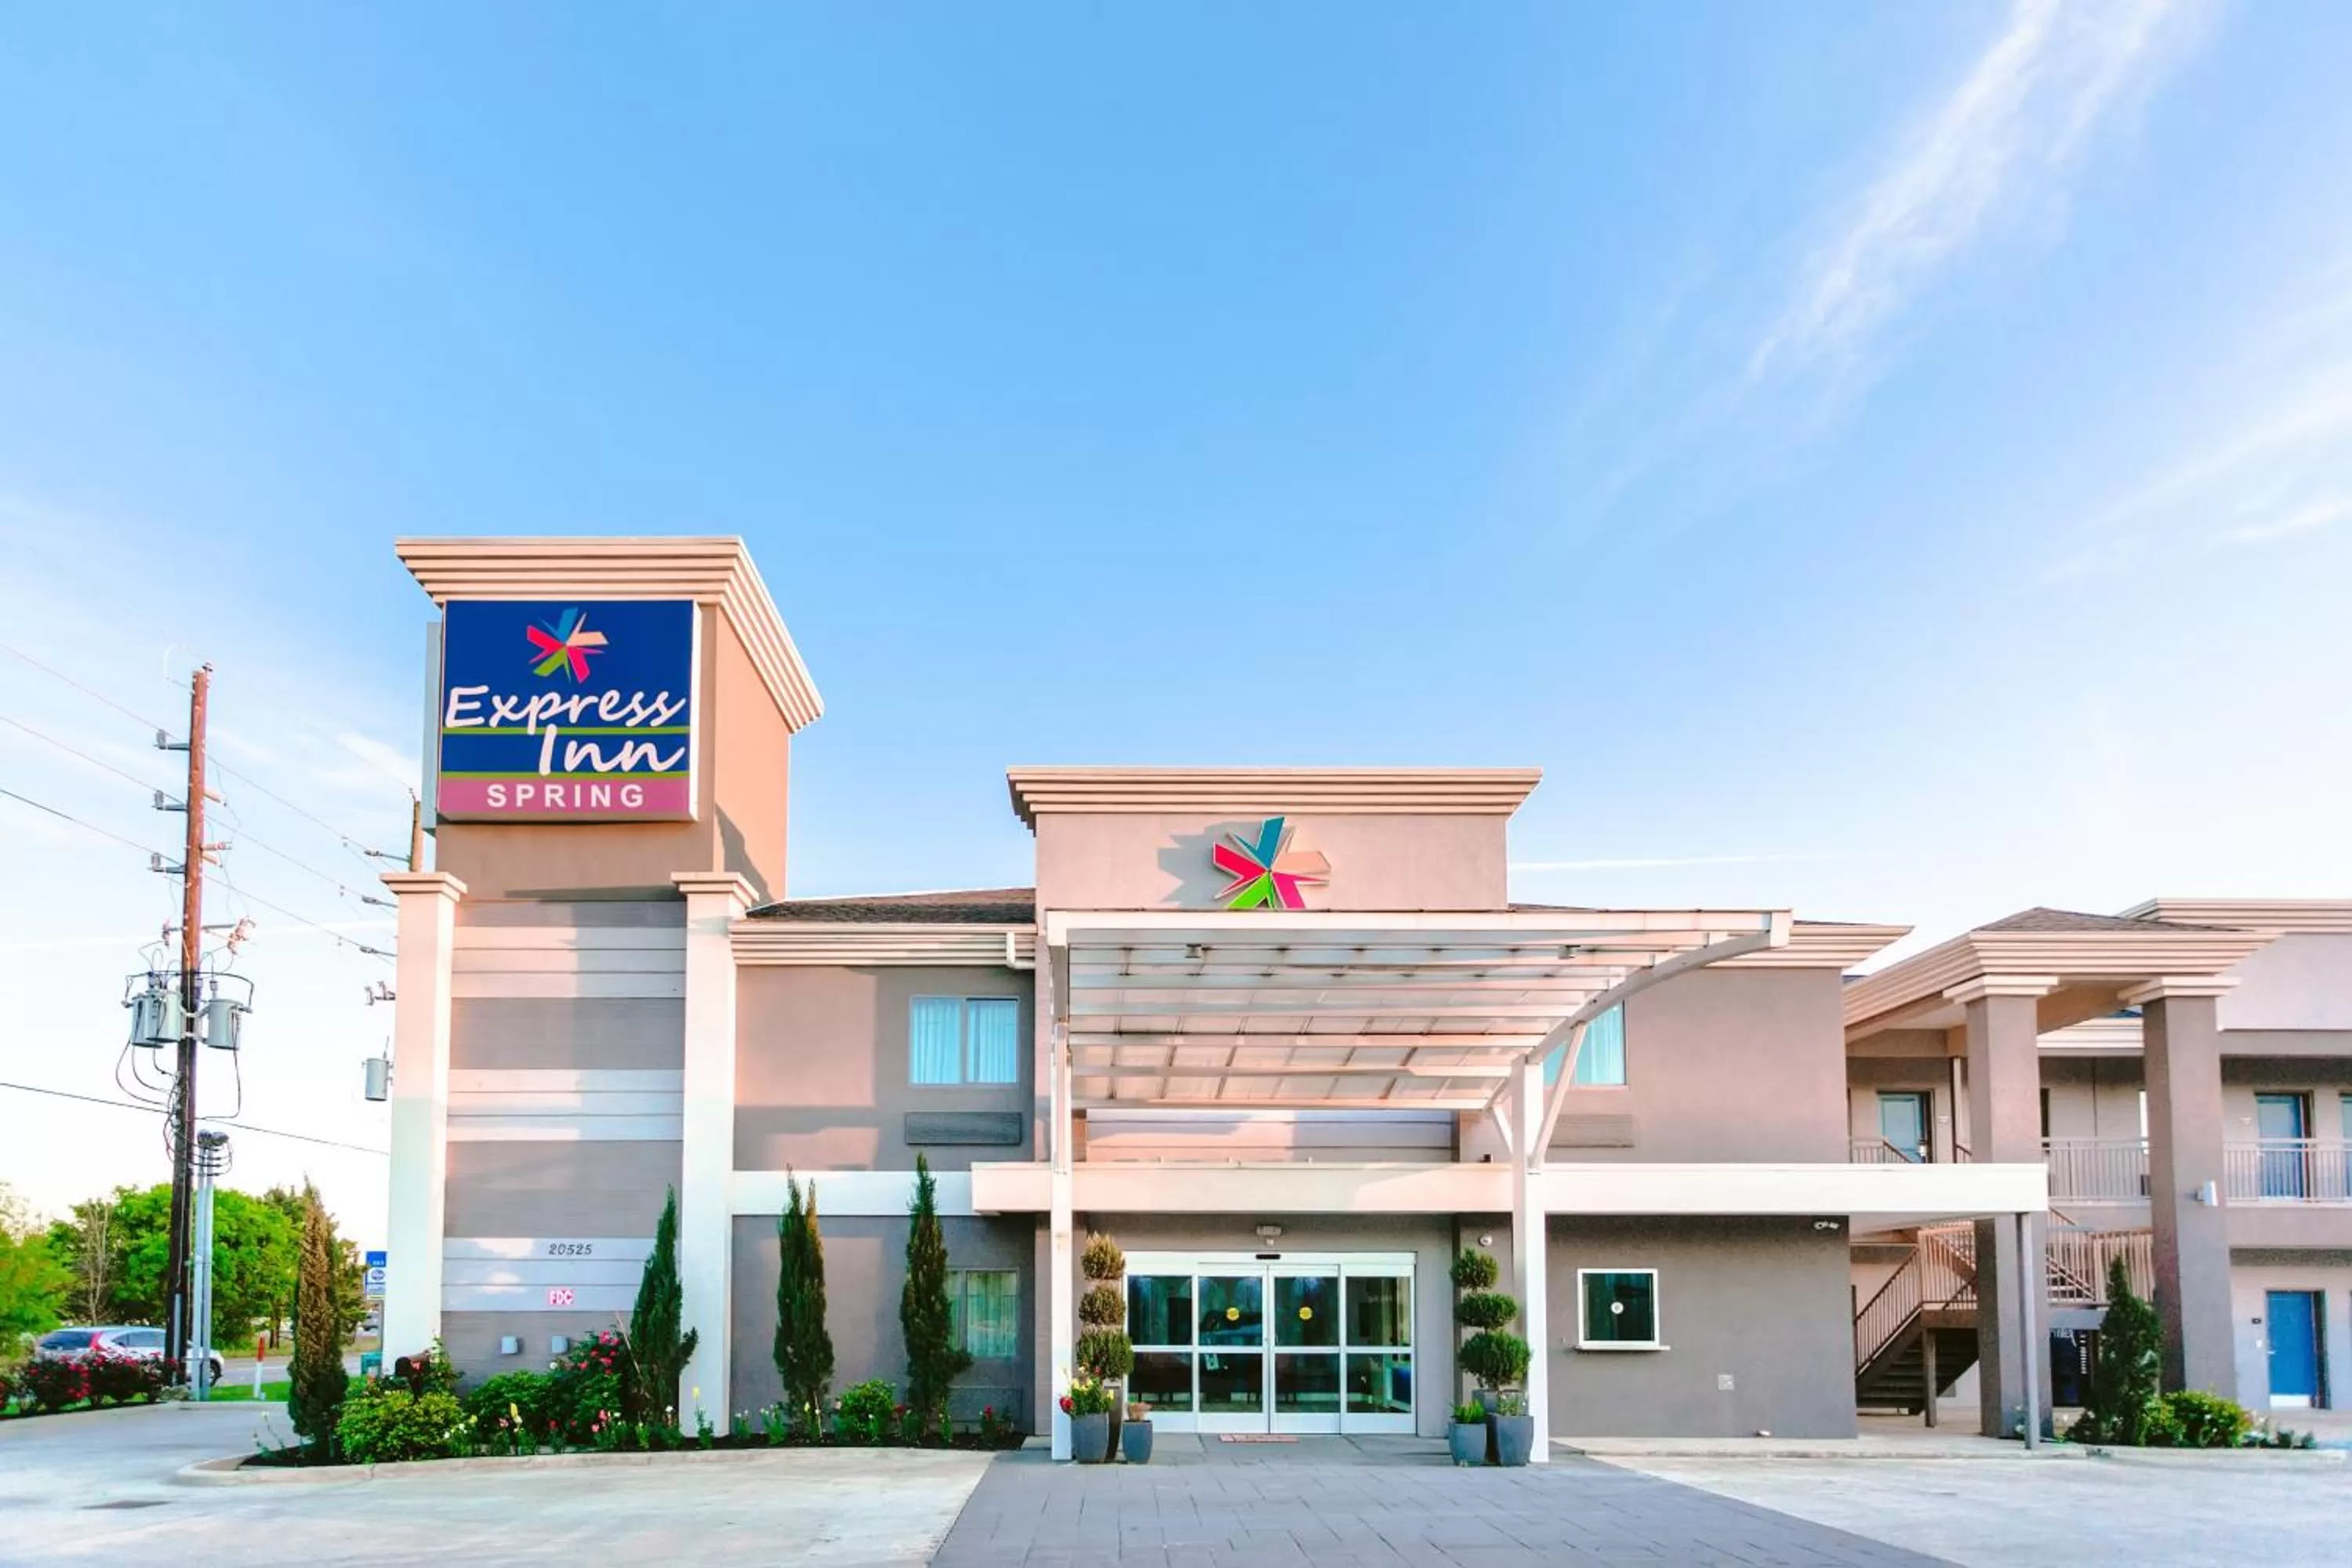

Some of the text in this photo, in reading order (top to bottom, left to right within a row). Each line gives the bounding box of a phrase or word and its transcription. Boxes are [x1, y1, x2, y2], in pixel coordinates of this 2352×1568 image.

[445, 684, 686, 735] Express
[539, 724, 685, 775] Inn
[487, 784, 644, 808] SPRING
[549, 1243, 593, 1255] 20525
[549, 1290, 574, 1305] FDC
